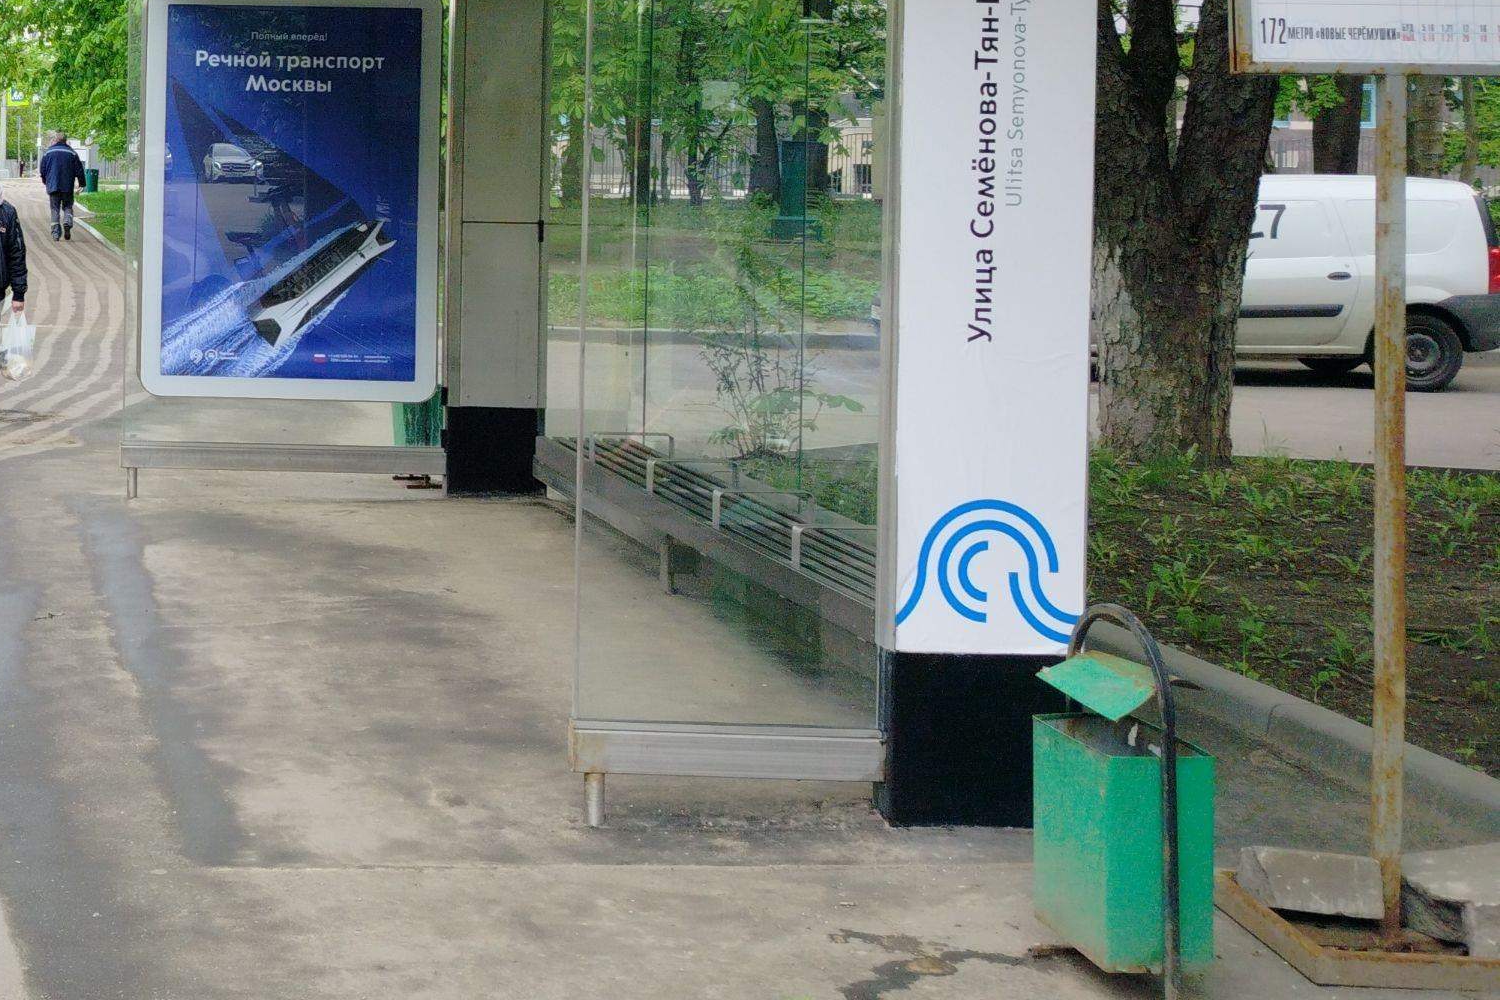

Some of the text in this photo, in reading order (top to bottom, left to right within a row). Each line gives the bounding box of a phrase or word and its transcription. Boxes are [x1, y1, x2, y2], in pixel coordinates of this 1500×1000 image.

[251, 32, 328, 42] Полный вперёд!
[1261, 18, 1286, 44] 172
[1288, 27, 1314, 40] МЕТРО
[195, 50, 385, 73] Речной транспорт
[245, 74, 332, 93] Москвы
[1005, 148, 1023, 207] Ulitsa
[967, 249, 997, 342] Улица
